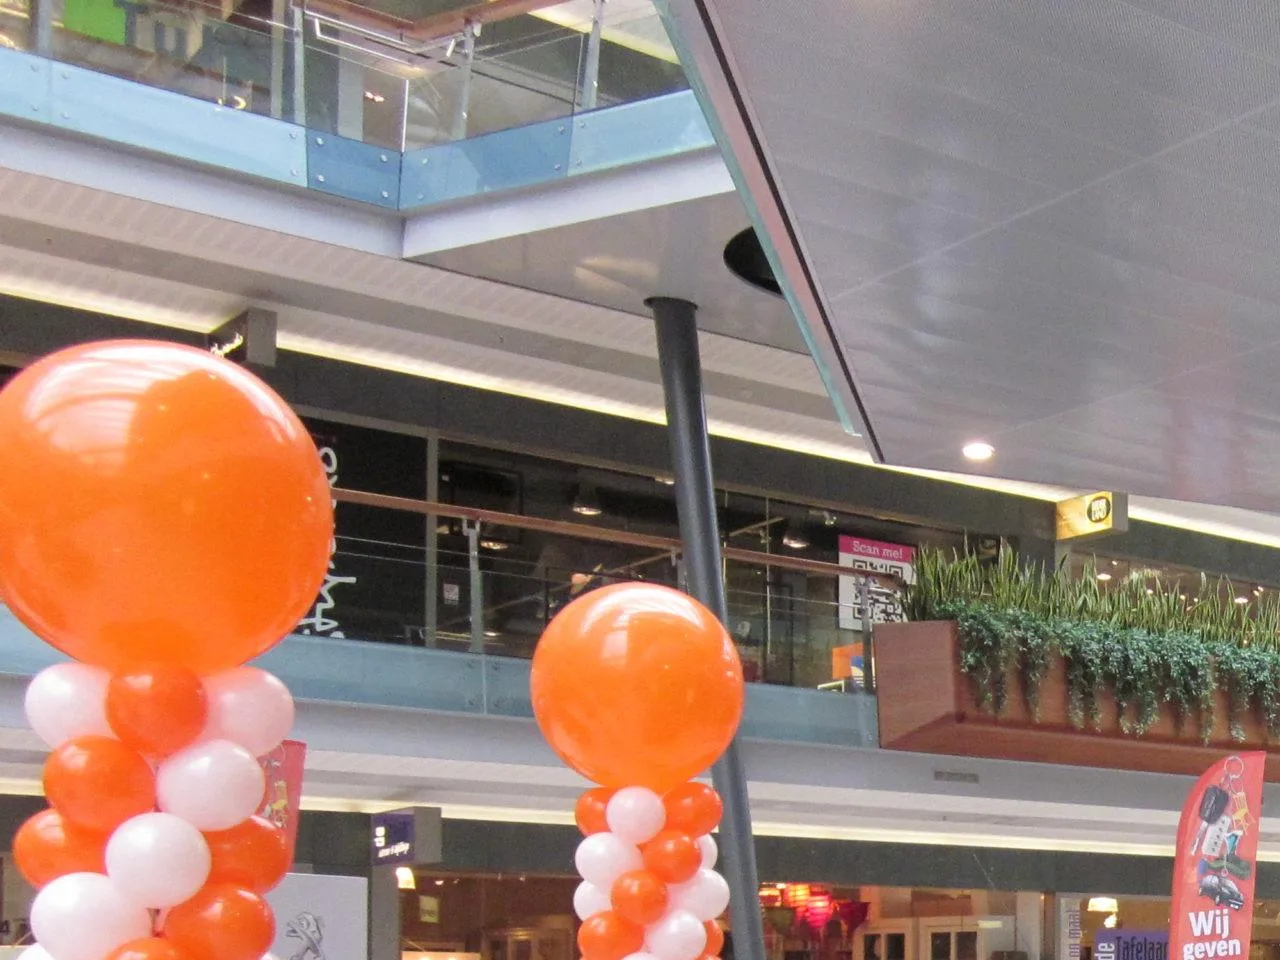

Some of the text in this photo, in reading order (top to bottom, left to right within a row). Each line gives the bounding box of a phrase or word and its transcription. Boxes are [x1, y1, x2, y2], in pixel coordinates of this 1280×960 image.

[852, 540, 903, 560] Scan me!
[1188, 909, 1230, 938] Wij
